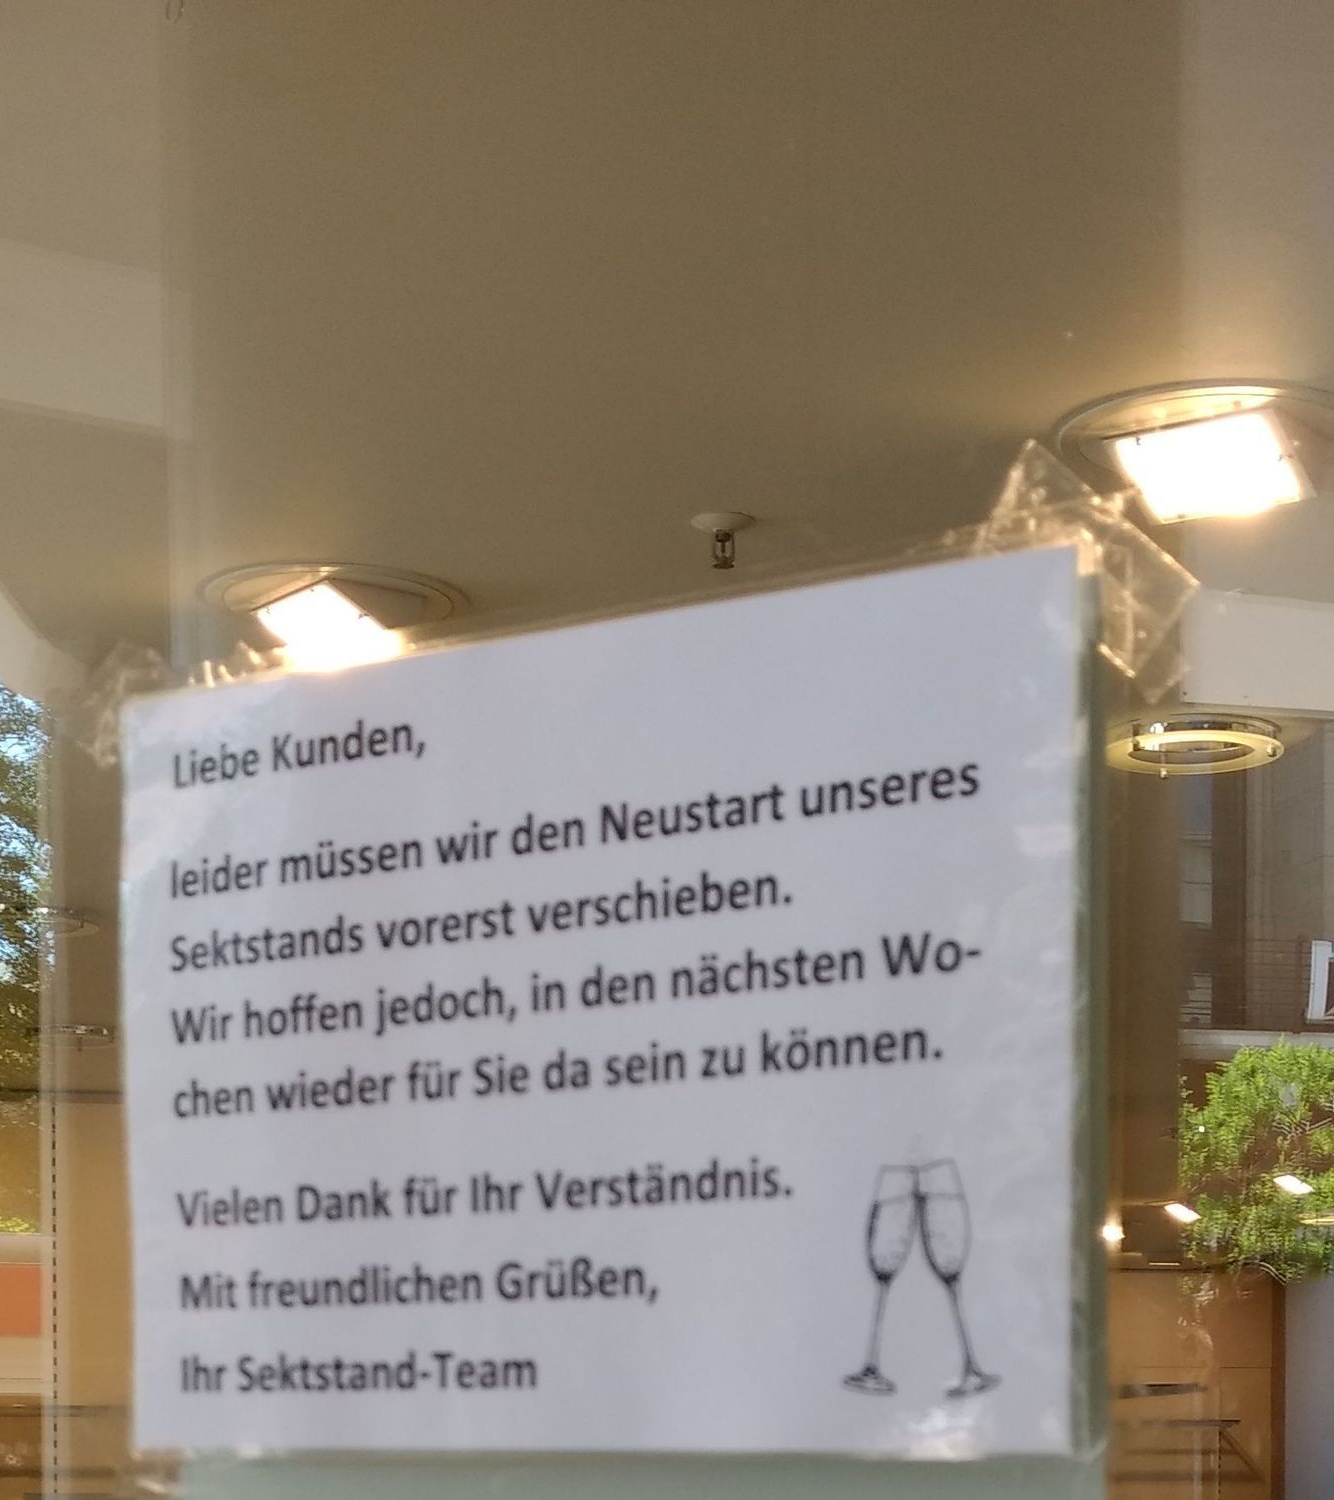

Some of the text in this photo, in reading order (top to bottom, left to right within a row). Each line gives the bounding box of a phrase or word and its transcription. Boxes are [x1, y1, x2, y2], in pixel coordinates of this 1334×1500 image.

[173, 719, 426, 789] Liebe Kunden,
[170, 762, 981, 899] leider müssen wir den Neustart unseres
[170, 871, 793, 973] Sektstands vorerst verschieben.
[170, 931, 982, 1046] Wir hoffen jedoch, in den nächsten Wo-
[173, 1027, 943, 1120] chen wieder für Sie da sein zu können.
[176, 1156, 792, 1228] Vielen Dank für Ihr Verständnis.
[179, 1255, 658, 1310] Mit freundlichen Grüßen,
[181, 1351, 538, 1393] Ihr Sektstand-Team
